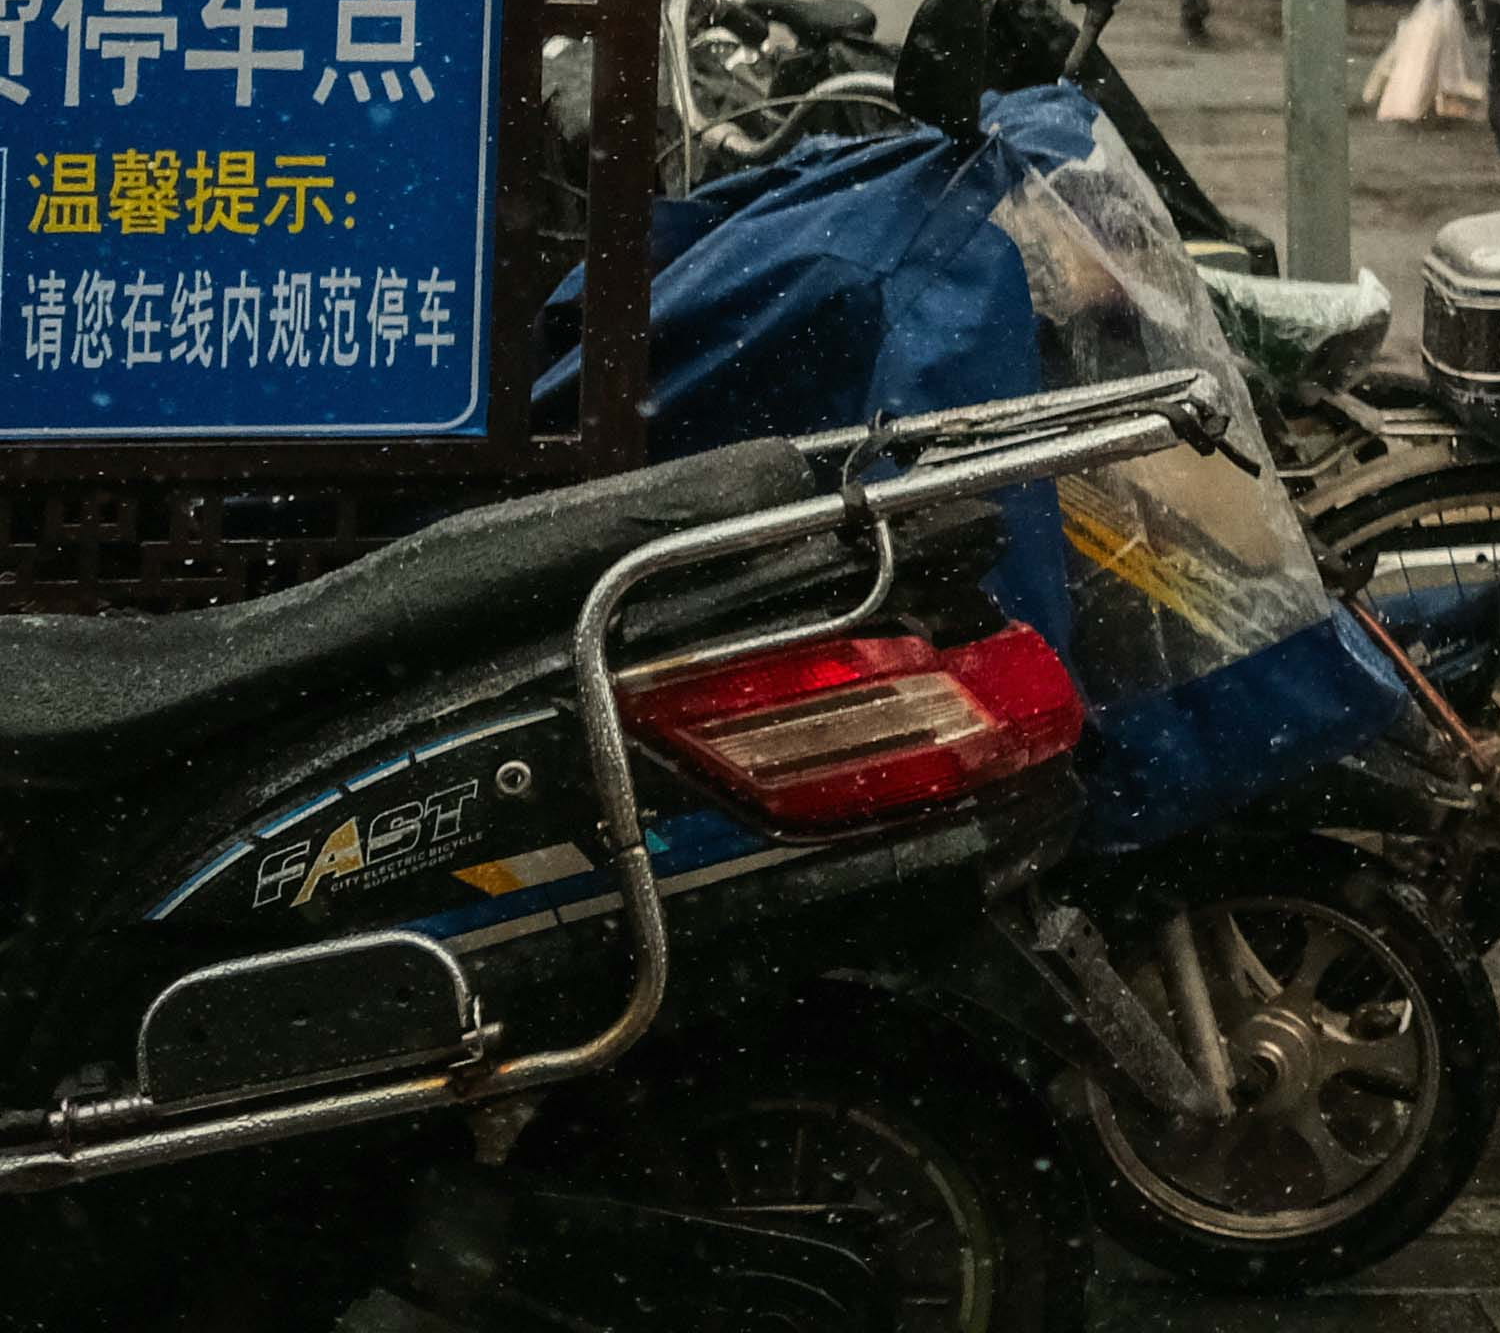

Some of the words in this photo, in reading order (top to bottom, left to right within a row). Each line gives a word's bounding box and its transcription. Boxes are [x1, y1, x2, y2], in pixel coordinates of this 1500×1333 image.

[21, 266, 457, 371] 请您在线内规范停车
[251, 779, 479, 909] FAST
[331, 874, 360, 893] CITY
[363, 851, 427, 881] ELECTRIC
[428, 832, 483, 858] BICYCLE
